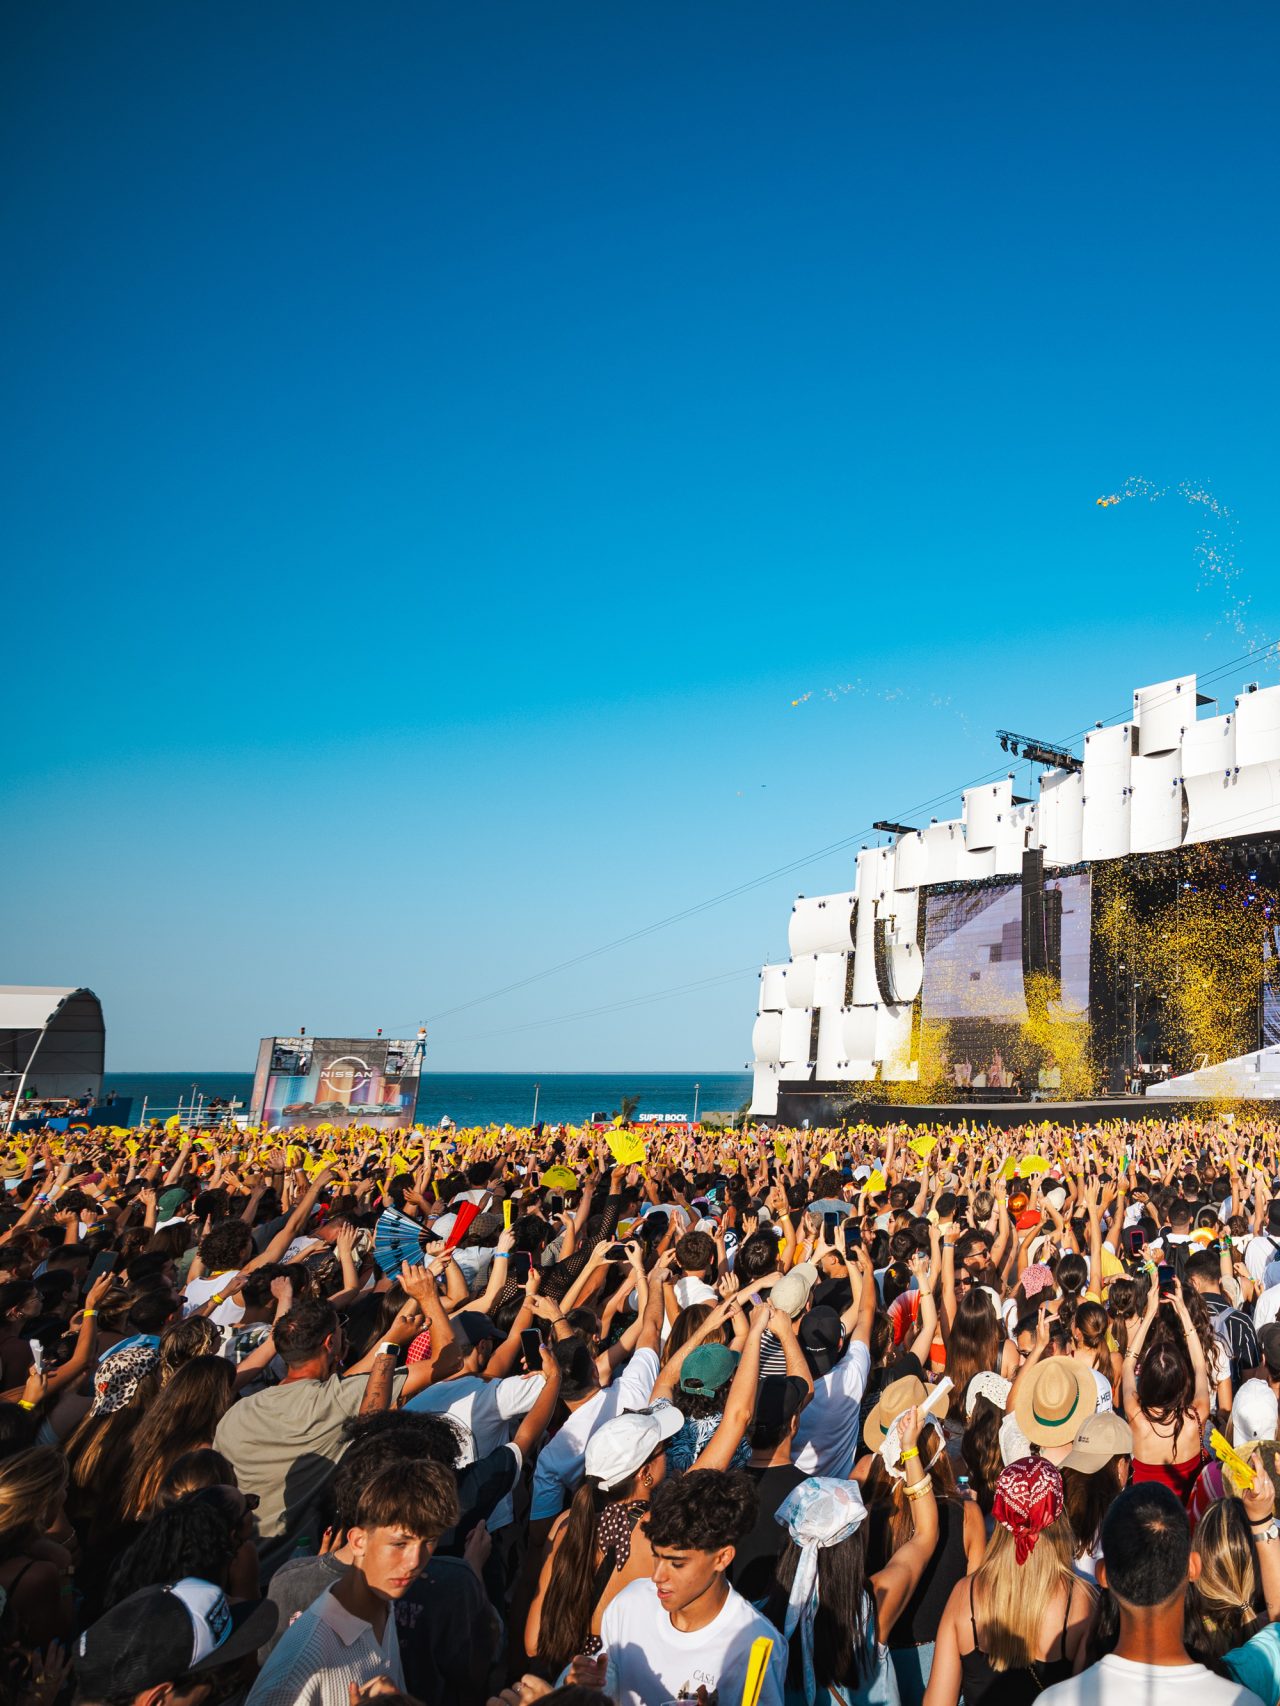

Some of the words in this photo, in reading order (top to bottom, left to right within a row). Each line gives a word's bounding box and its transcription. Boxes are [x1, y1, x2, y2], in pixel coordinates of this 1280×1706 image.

[639, 1113, 664, 1122] SUPER
[665, 1113, 688, 1122] BOCK
[692, 1669, 715, 1685] CASA
